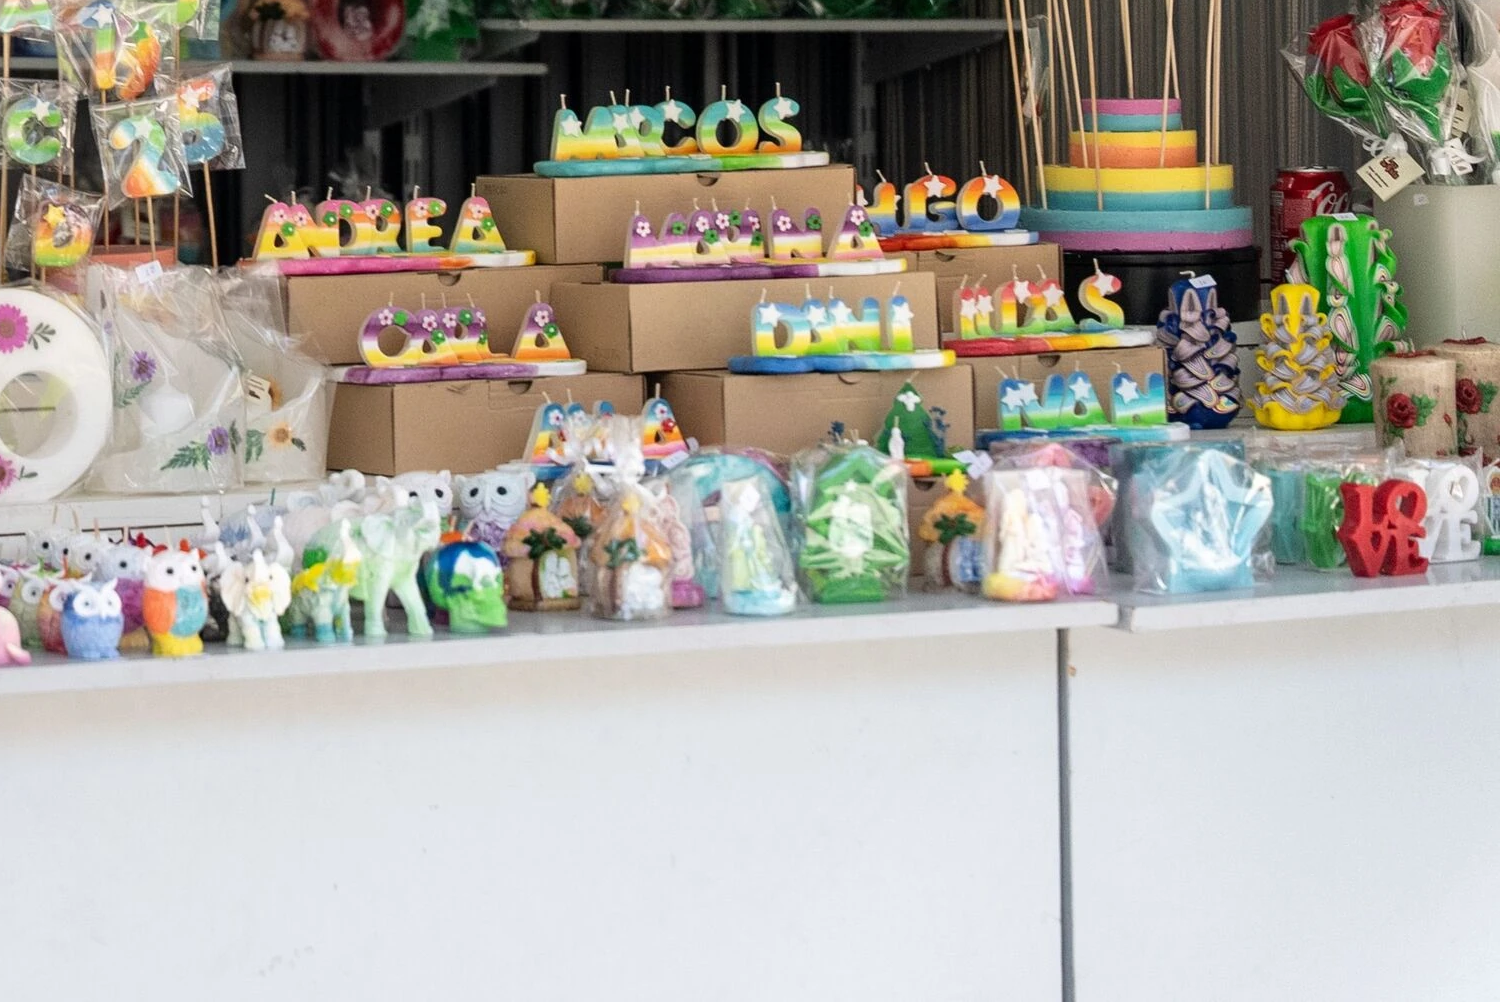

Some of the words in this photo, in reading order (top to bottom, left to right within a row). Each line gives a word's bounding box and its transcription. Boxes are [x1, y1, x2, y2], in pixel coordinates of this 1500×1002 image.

[3, 95, 64, 166] C
[108, 113, 180, 199] 2
[551, 97, 803, 161] MARCOS
[252, 197, 507, 260] ANDREA
[624, 204, 886, 268] MARINA
[358, 303, 572, 367] CARLA
[751, 295, 914, 356] DANI
[954, 272, 1125, 339] LUCAS
[1340, 479, 1428, 529] LO
[1337, 526, 1429, 577] VE
